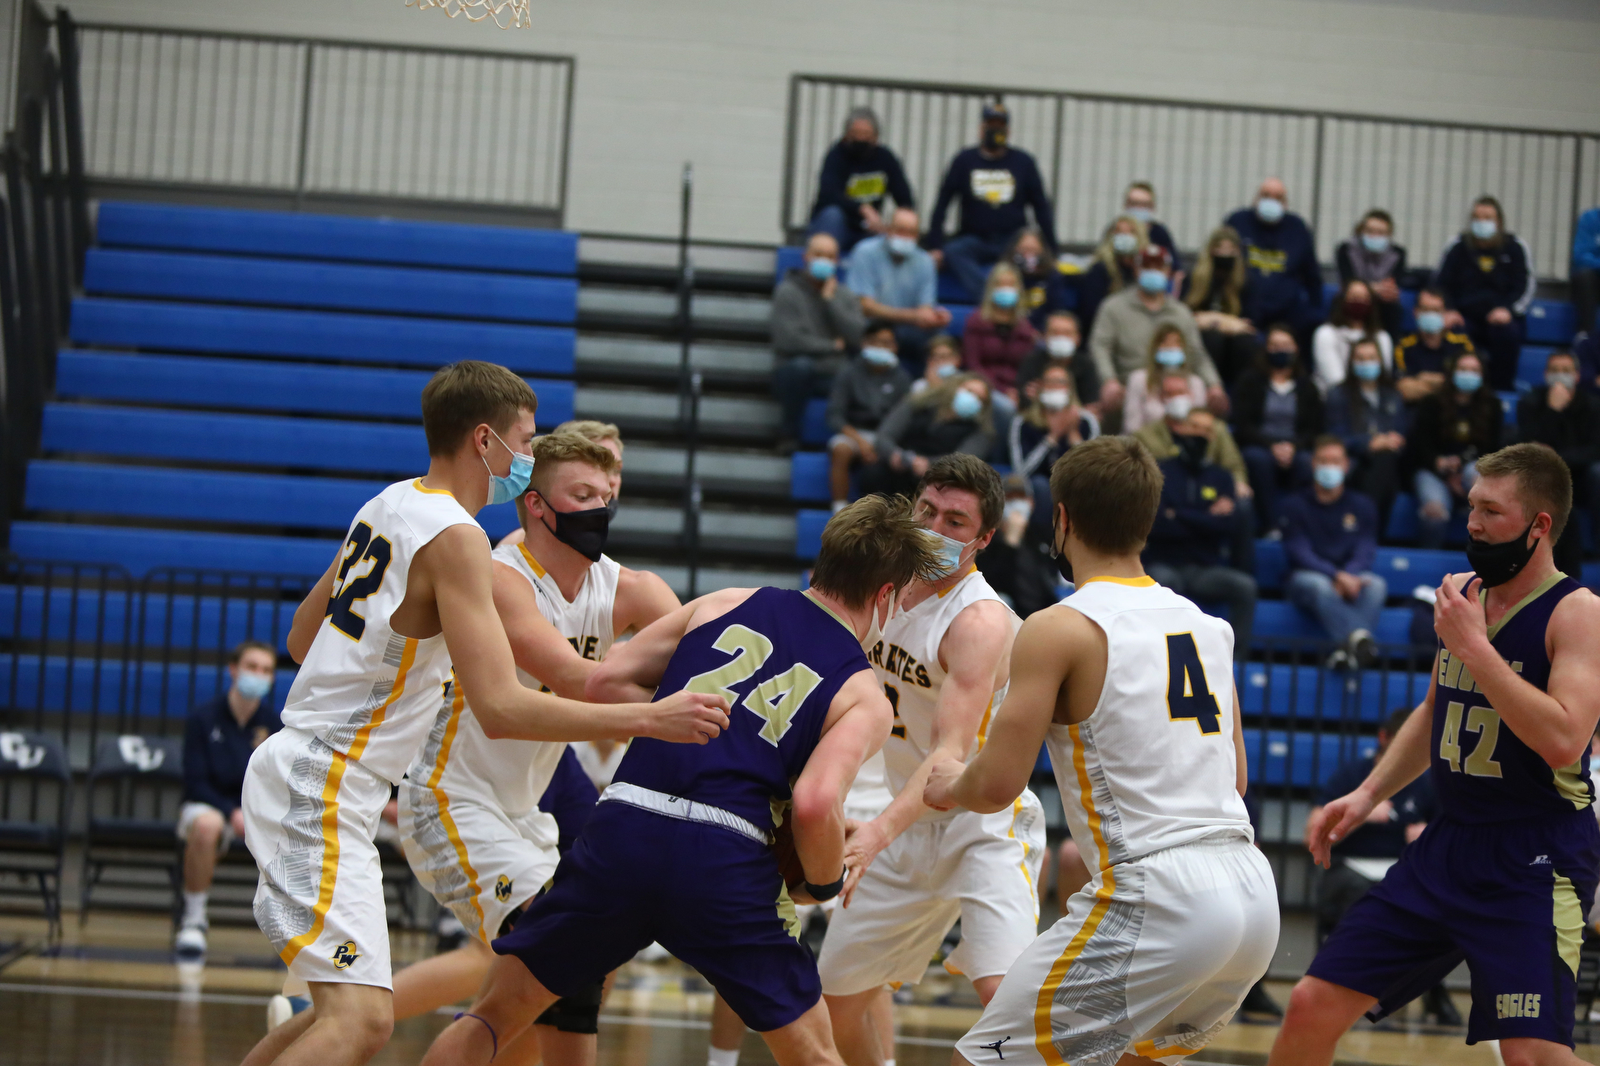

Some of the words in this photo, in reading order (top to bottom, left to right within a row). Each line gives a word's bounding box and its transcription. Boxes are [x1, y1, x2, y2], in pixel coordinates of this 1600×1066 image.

[683, 624, 825, 748] 24
[868, 640, 932, 689] RATES
[1164, 630, 1223, 737] 4
[1440, 701, 1503, 779] 42
[1496, 993, 1542, 1019] EAGLES
